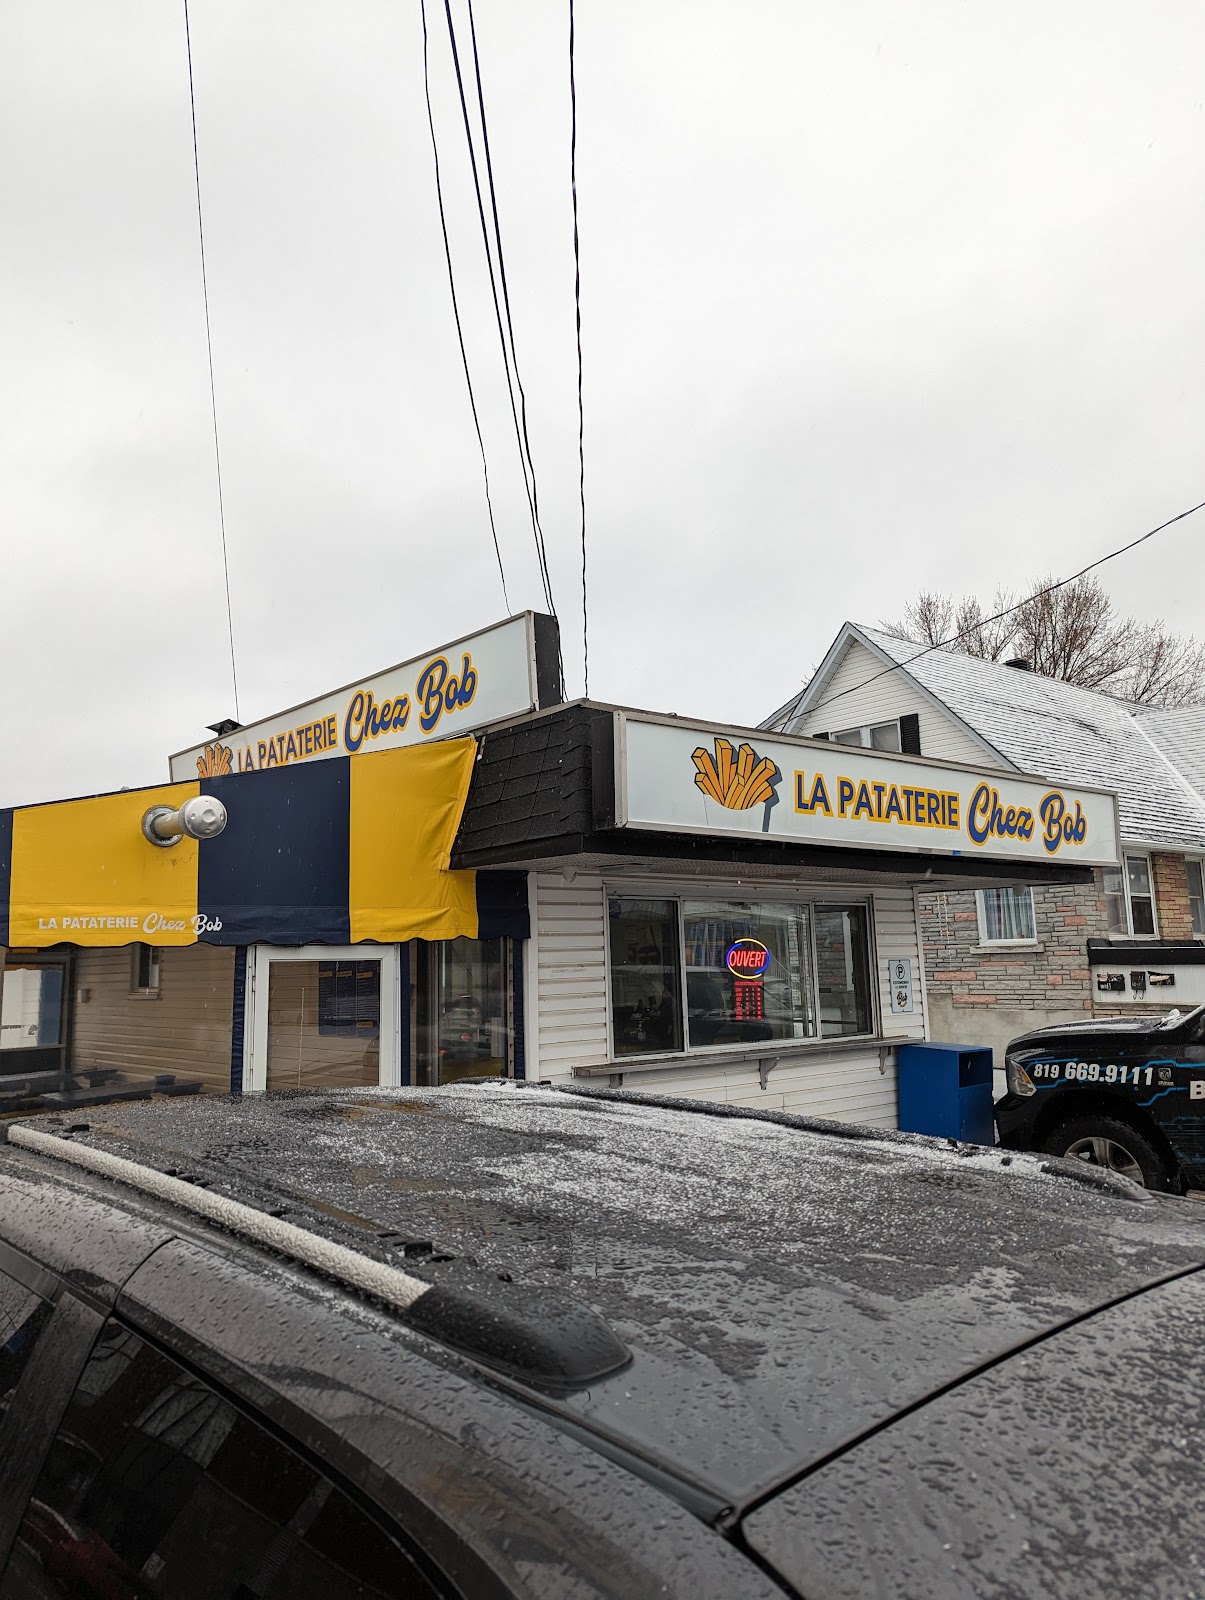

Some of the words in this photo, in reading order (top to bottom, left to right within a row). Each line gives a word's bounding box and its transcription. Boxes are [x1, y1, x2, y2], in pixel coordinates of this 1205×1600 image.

[257, 713, 338, 769] PATATERIE
[343, 689, 411, 754] Chez
[416, 652, 478, 735] Bob
[794, 770, 833, 817] LA
[837, 774, 960, 830] PATATERIE
[966, 781, 1034, 846] Chez
[1040, 790, 1088, 855] Bob
[39, 917, 57, 930] LA
[62, 916, 139, 929] PATATERIE
[142, 912, 187, 934] Chez
[190, 913, 223, 935] Bob
[729, 950, 766, 968] OUVERT
[1034, 1064, 1060, 1079] 819
[1065, 1062, 1153, 1085] 669.9111
